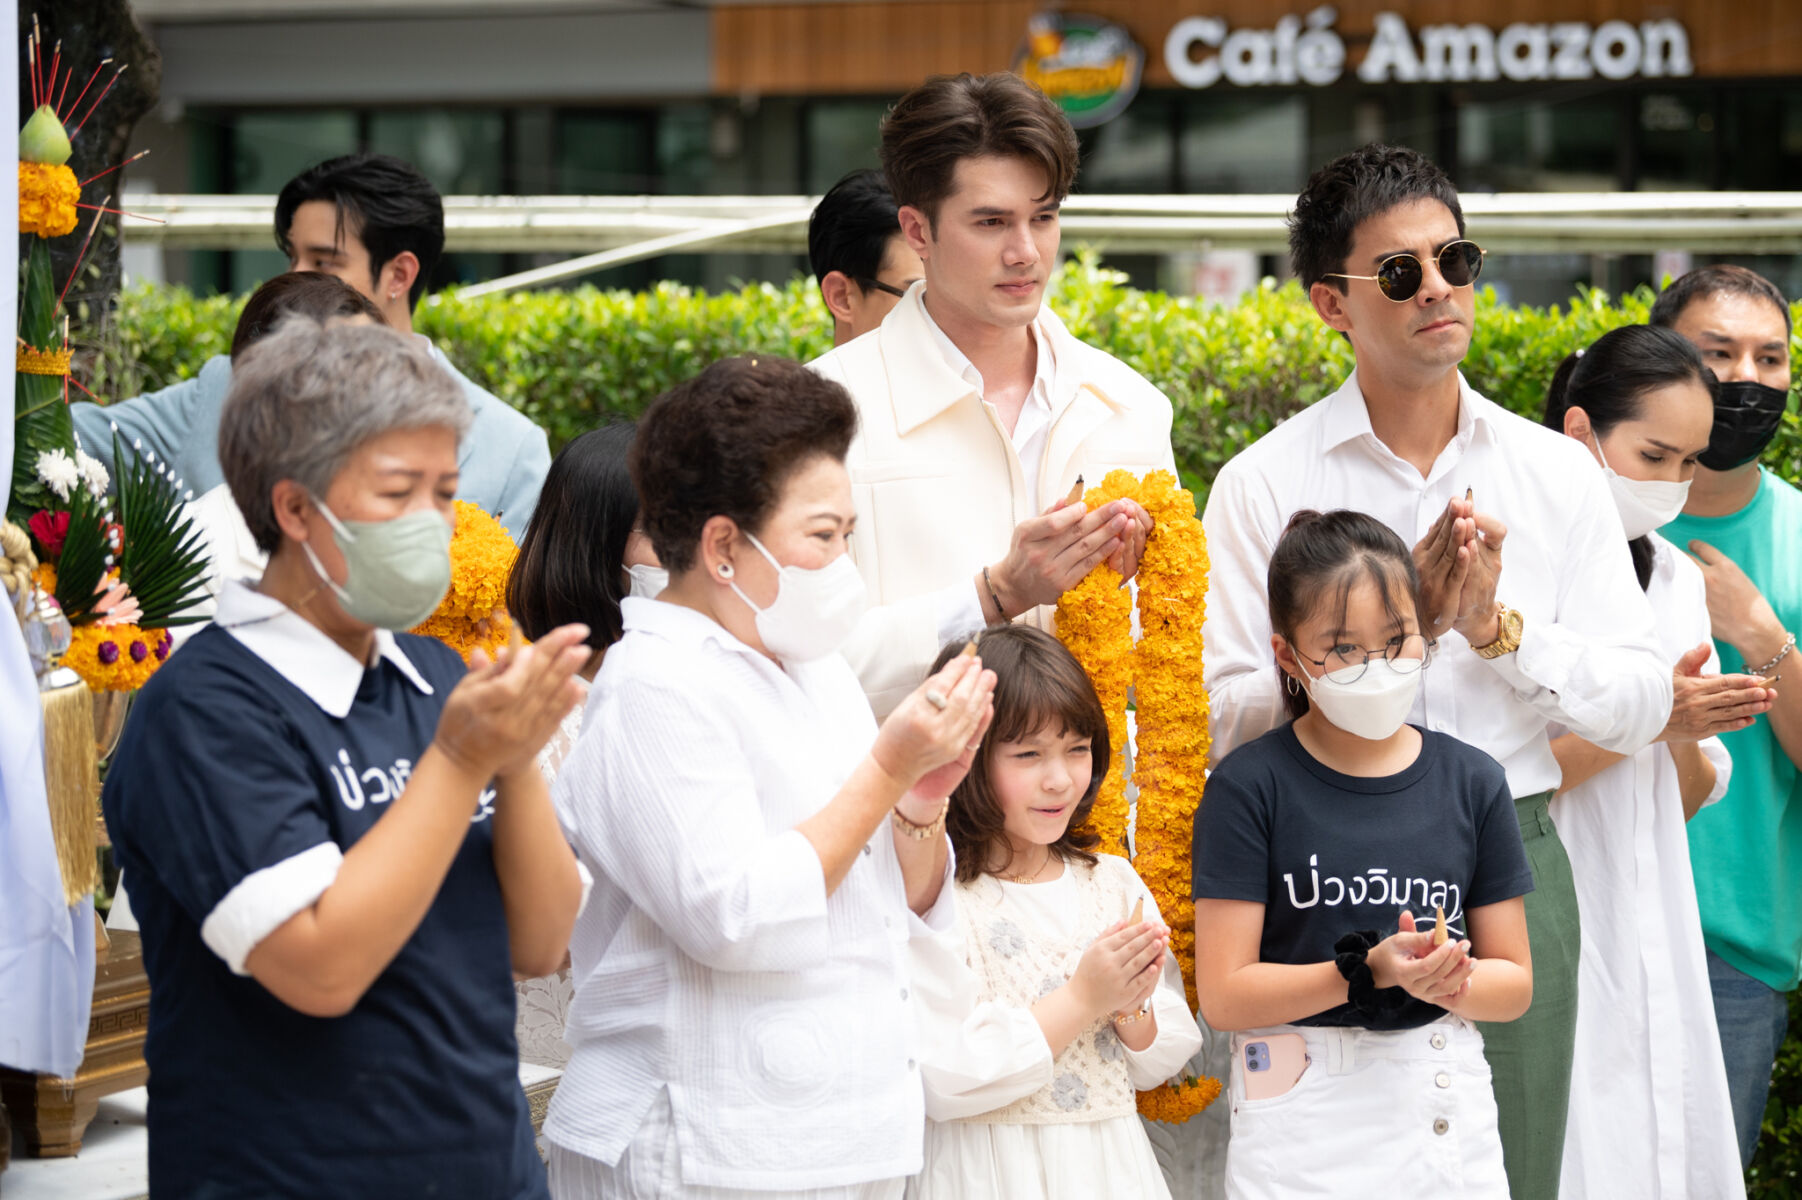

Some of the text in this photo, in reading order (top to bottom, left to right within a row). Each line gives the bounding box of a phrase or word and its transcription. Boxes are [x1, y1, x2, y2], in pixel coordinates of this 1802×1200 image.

[1164, 5, 1346, 89] Café
[1356, 12, 1694, 83] Amazon
[1283, 853, 1462, 922] บ่วงวิมาลา
